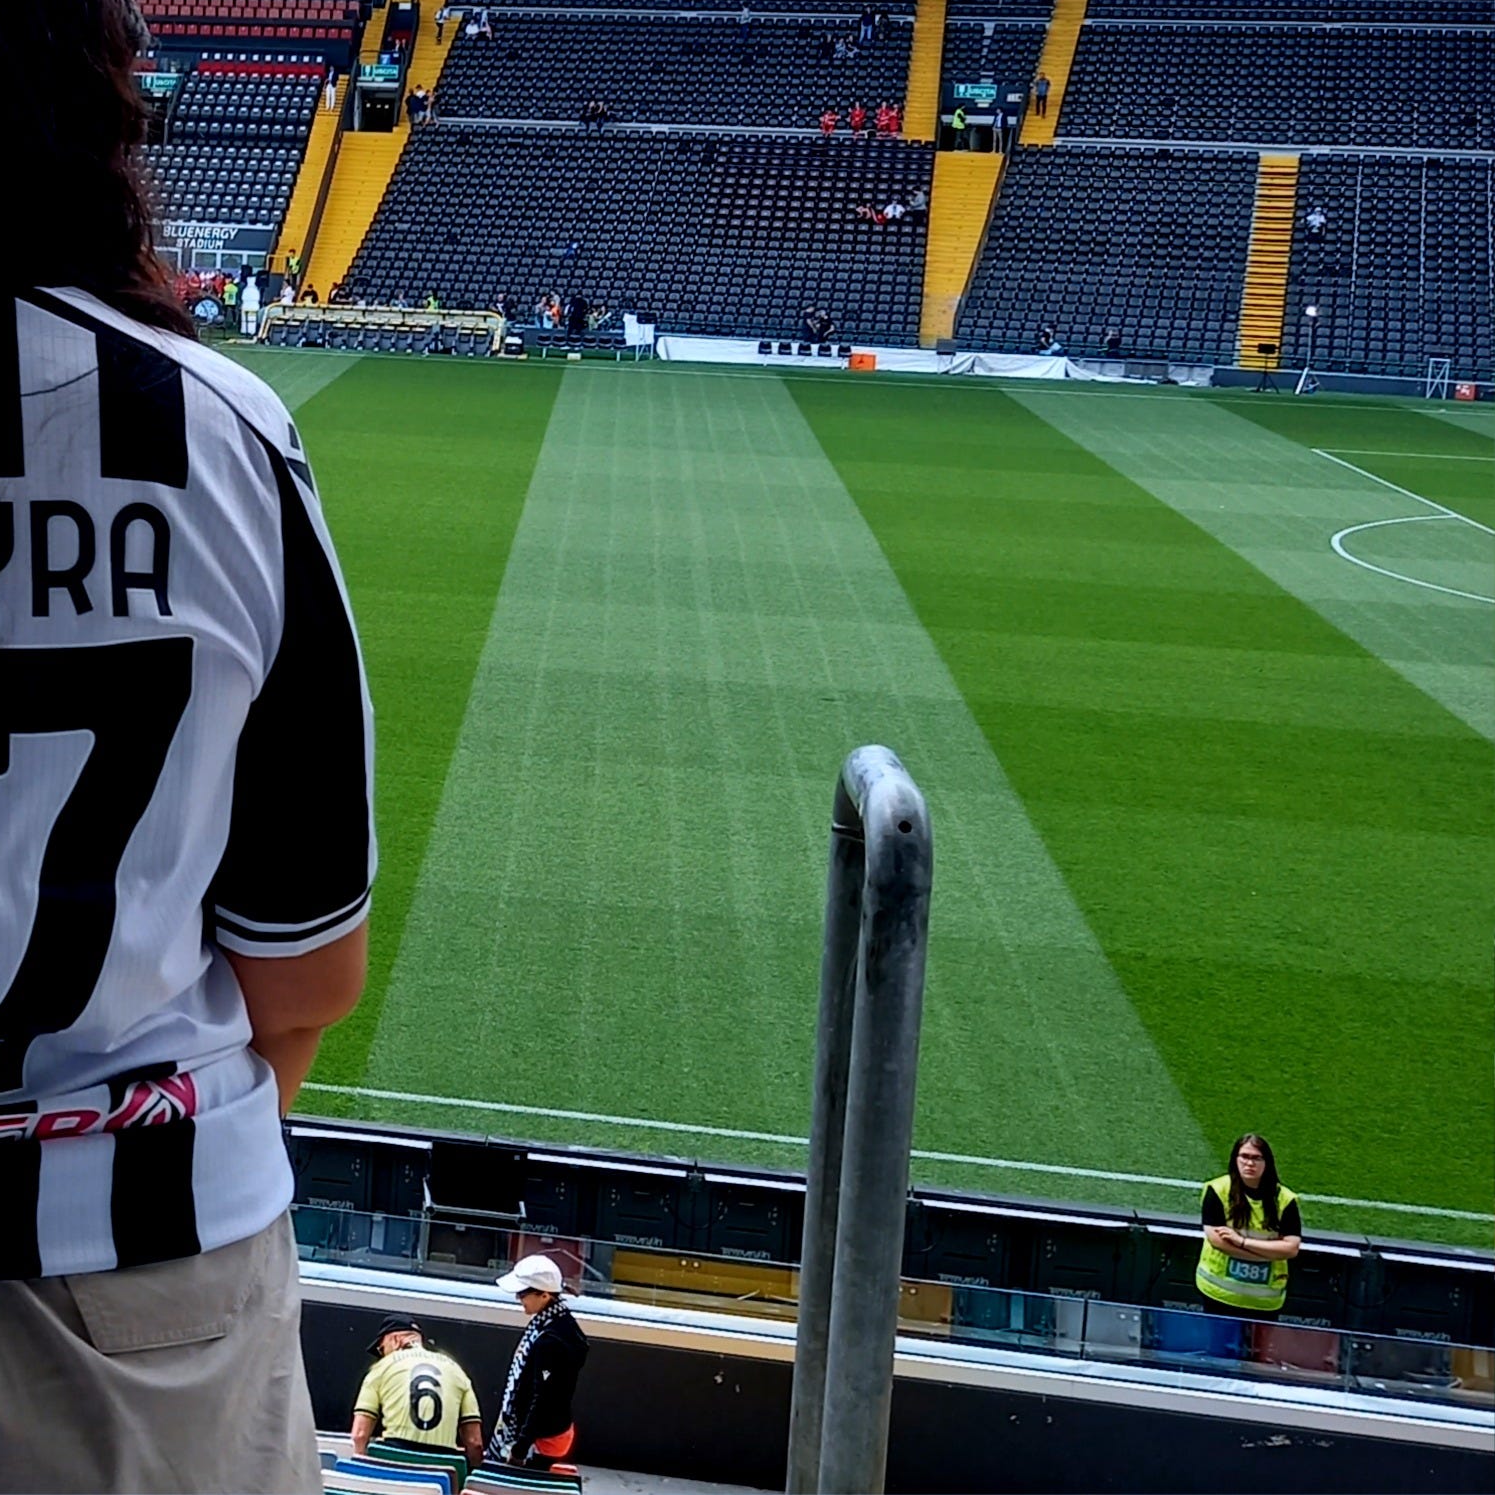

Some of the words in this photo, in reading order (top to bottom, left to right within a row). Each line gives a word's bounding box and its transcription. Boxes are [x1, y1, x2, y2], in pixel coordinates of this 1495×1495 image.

[162, 225, 238, 240] BLUENERGY
[176, 238, 224, 249] STADIUM
[1228, 1259, 1268, 1281] U381
[409, 1372, 443, 1431] 6
